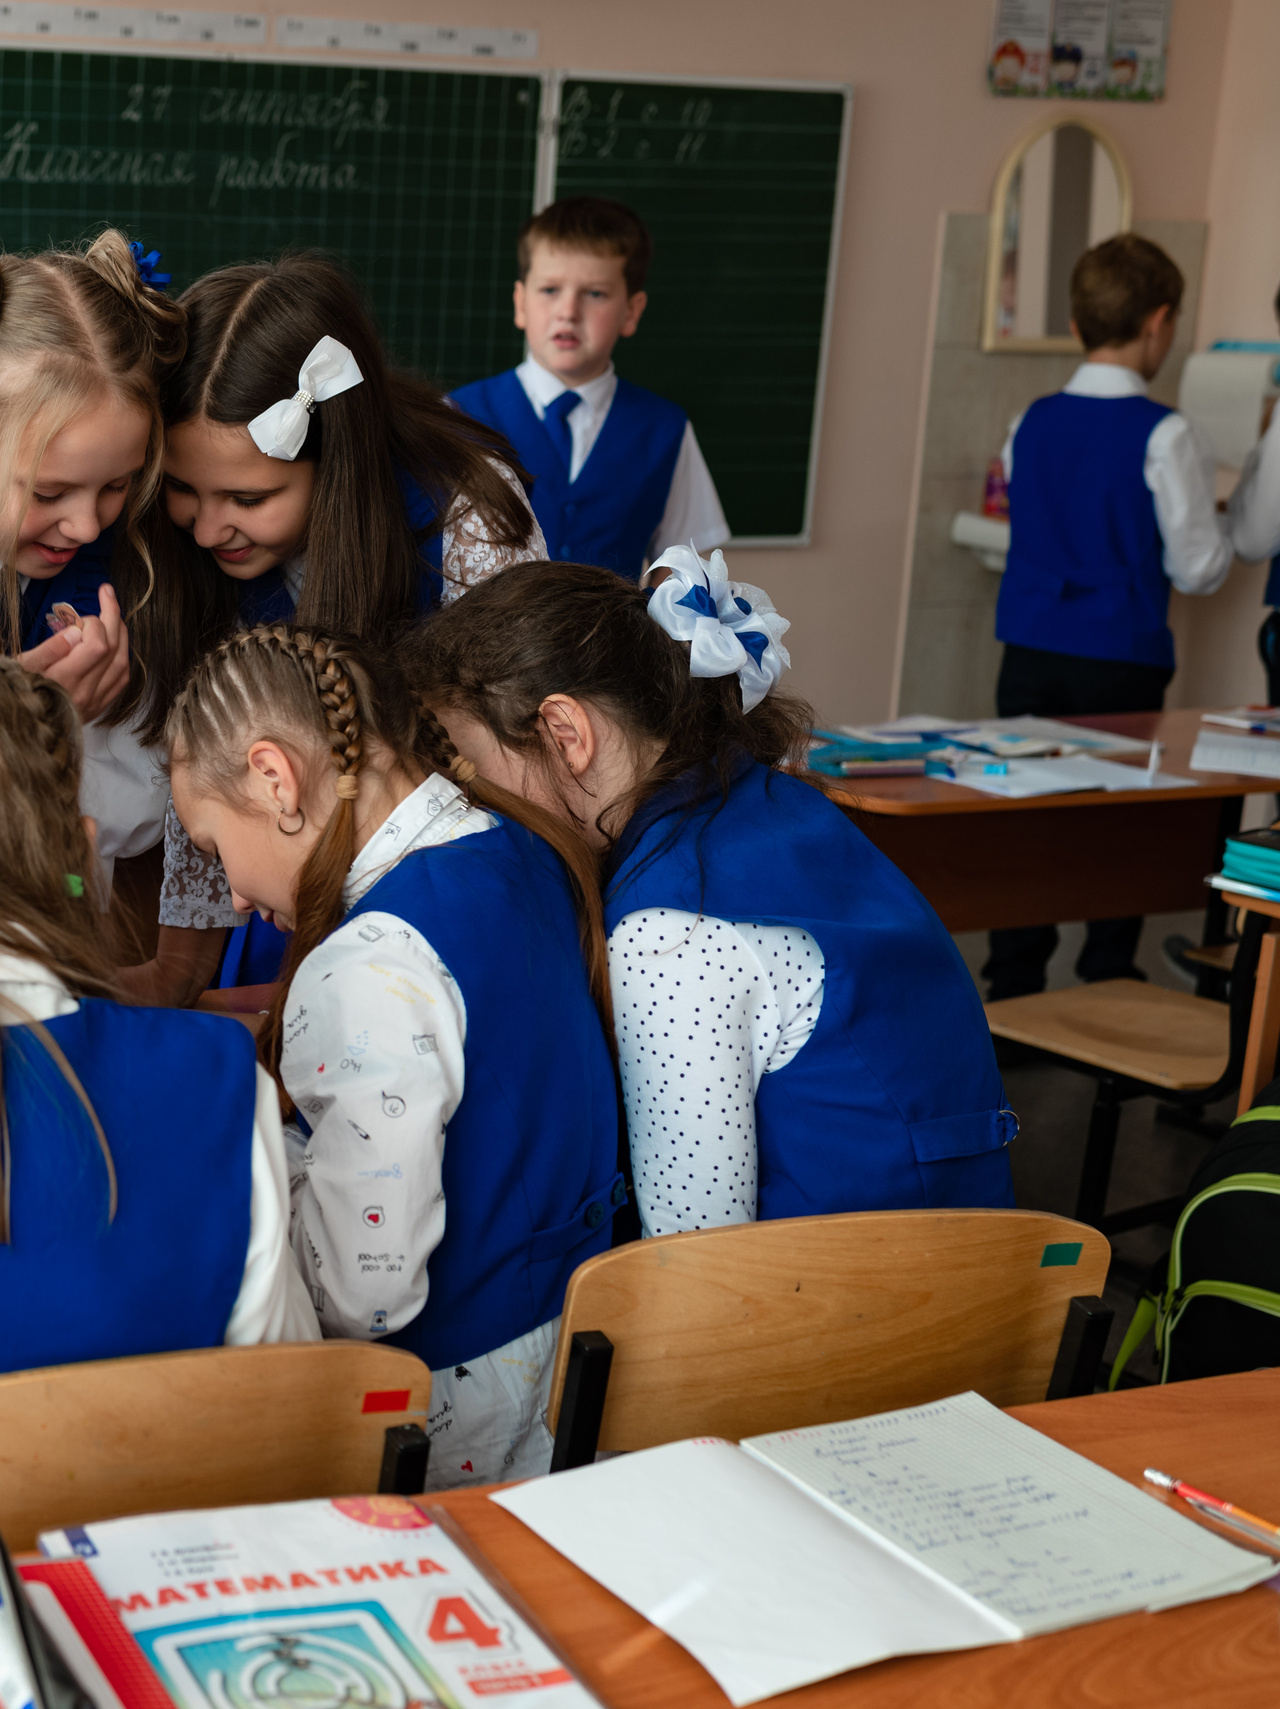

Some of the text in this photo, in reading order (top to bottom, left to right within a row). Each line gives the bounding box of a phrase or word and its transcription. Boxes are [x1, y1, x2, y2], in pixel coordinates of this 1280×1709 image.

[209, 131, 360, 209] работа
[110, 1555, 450, 1614] МАТЕМАТИКА
[426, 1596, 503, 1650] 4
